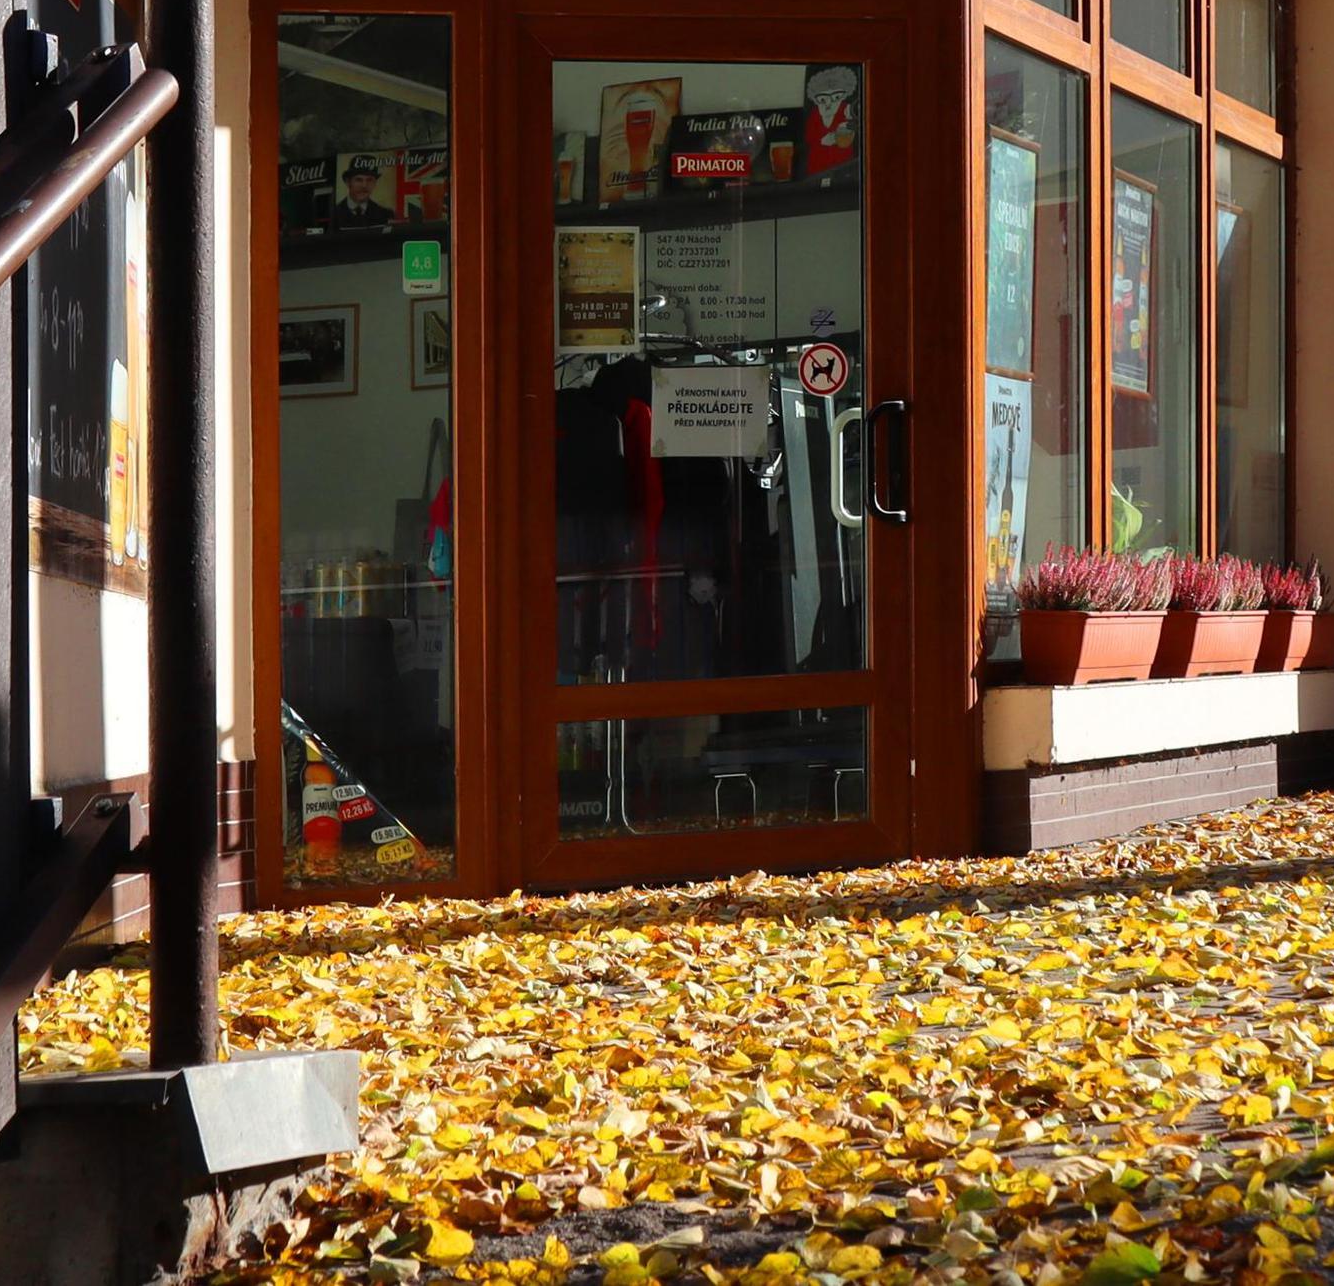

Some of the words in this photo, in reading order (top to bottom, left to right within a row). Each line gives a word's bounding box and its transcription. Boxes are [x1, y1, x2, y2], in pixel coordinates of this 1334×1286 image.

[686, 116, 726, 134] India
[763, 113, 789, 129] Ale
[354, 155, 397, 170] English
[676, 155, 746, 174] PRIMATOR
[285, 161, 328, 186] Stout
[675, 387, 719, 398] VĚRNOSTNÍ
[720, 388, 747, 398] KARTU
[667, 400, 754, 415] PŘEDKLÁDEJTE
[674, 417, 695, 427] PŘED
[696, 417, 736, 427] NÁKUPEM
[558, 800, 604, 817] IMATO
